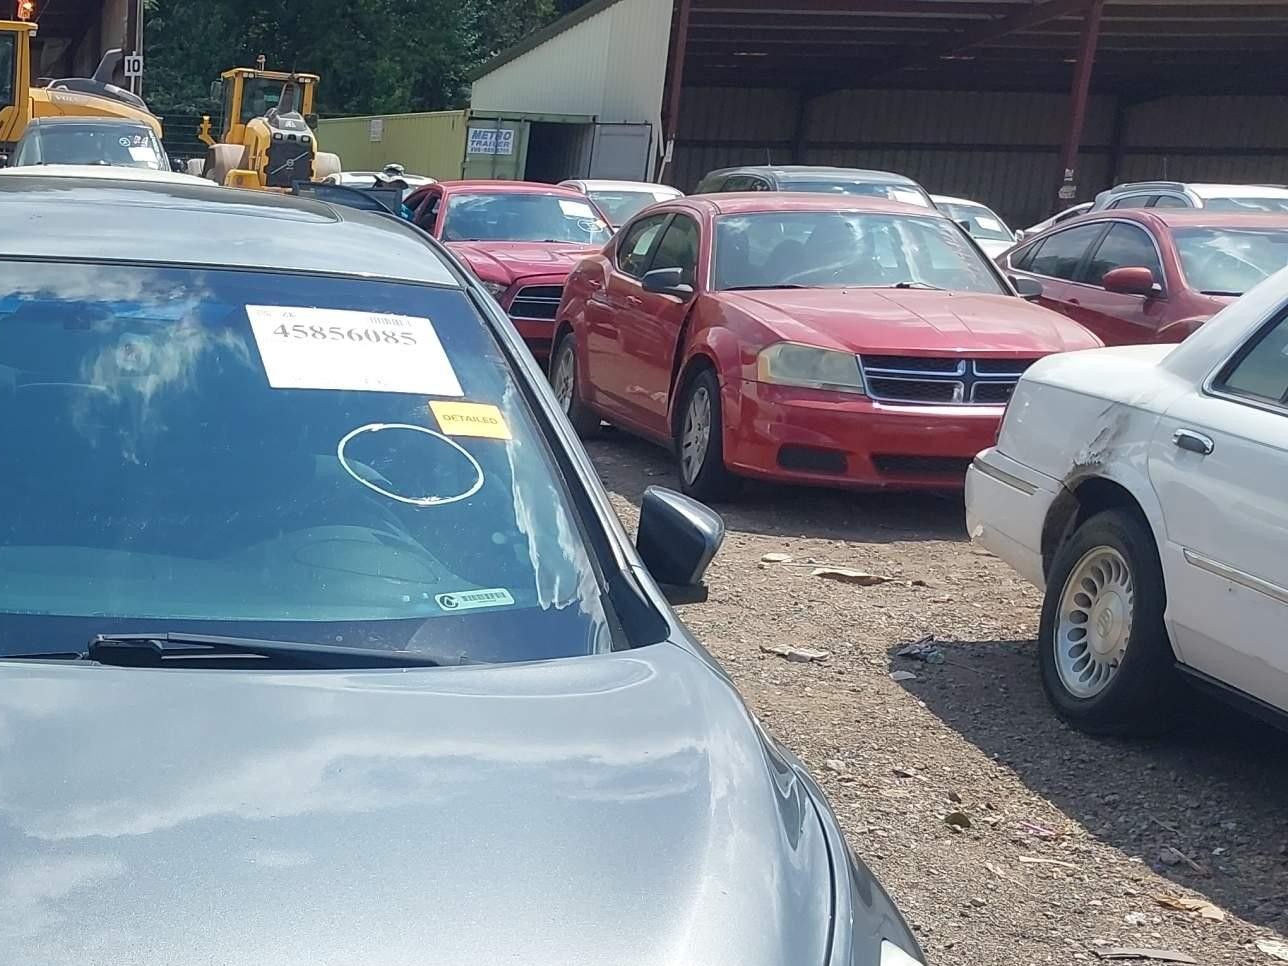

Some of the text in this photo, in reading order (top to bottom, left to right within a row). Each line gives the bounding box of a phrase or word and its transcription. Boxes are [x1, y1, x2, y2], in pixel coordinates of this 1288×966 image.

[126, 59, 141, 73] 10
[471, 130, 512, 141] METRO
[273, 323, 418, 346] 45856085
[442, 414, 498, 425] DETAILED
